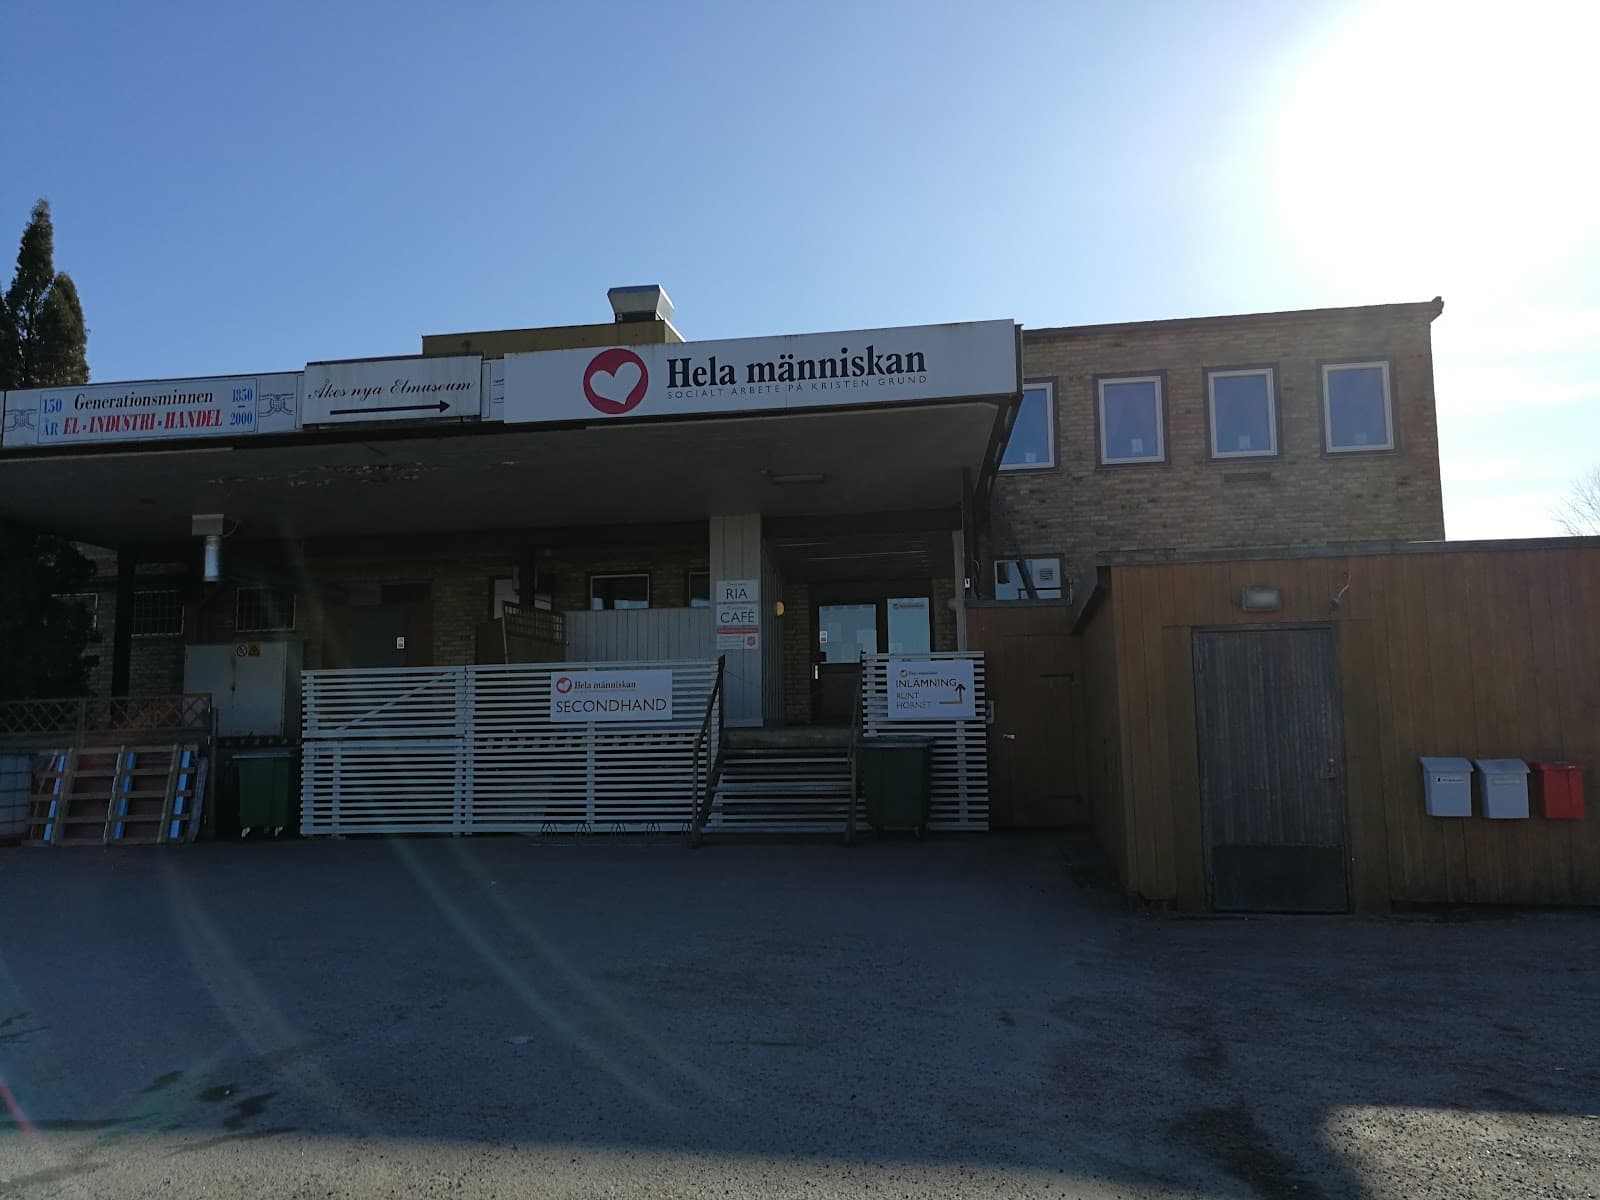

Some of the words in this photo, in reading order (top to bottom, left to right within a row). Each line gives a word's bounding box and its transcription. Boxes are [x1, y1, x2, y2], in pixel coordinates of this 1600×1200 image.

[667, 355, 737, 389] Hela
[746, 344, 927, 384] människan
[351, 386, 384, 401] nya
[390, 377, 473, 394] Elmuseum
[667, 388, 722, 400] SOCIALT
[731, 384, 781, 396] ARBETE
[788, 382, 803, 392] PÅ
[812, 379, 869, 391] KRISTEN
[878, 375, 927, 386] GRUND
[44, 398, 62, 415] 150
[75, 389, 213, 410] Generationsminnen
[231, 388, 253, 403] 1850
[42, 419, 58, 436] ÅR
[230, 411, 253, 426] 2000
[574, 680, 592, 689] Hela
[593, 680, 637, 689] människan
[895, 677, 957, 689] INLÄMNING
[556, 698, 667, 713] SECONDHAND
